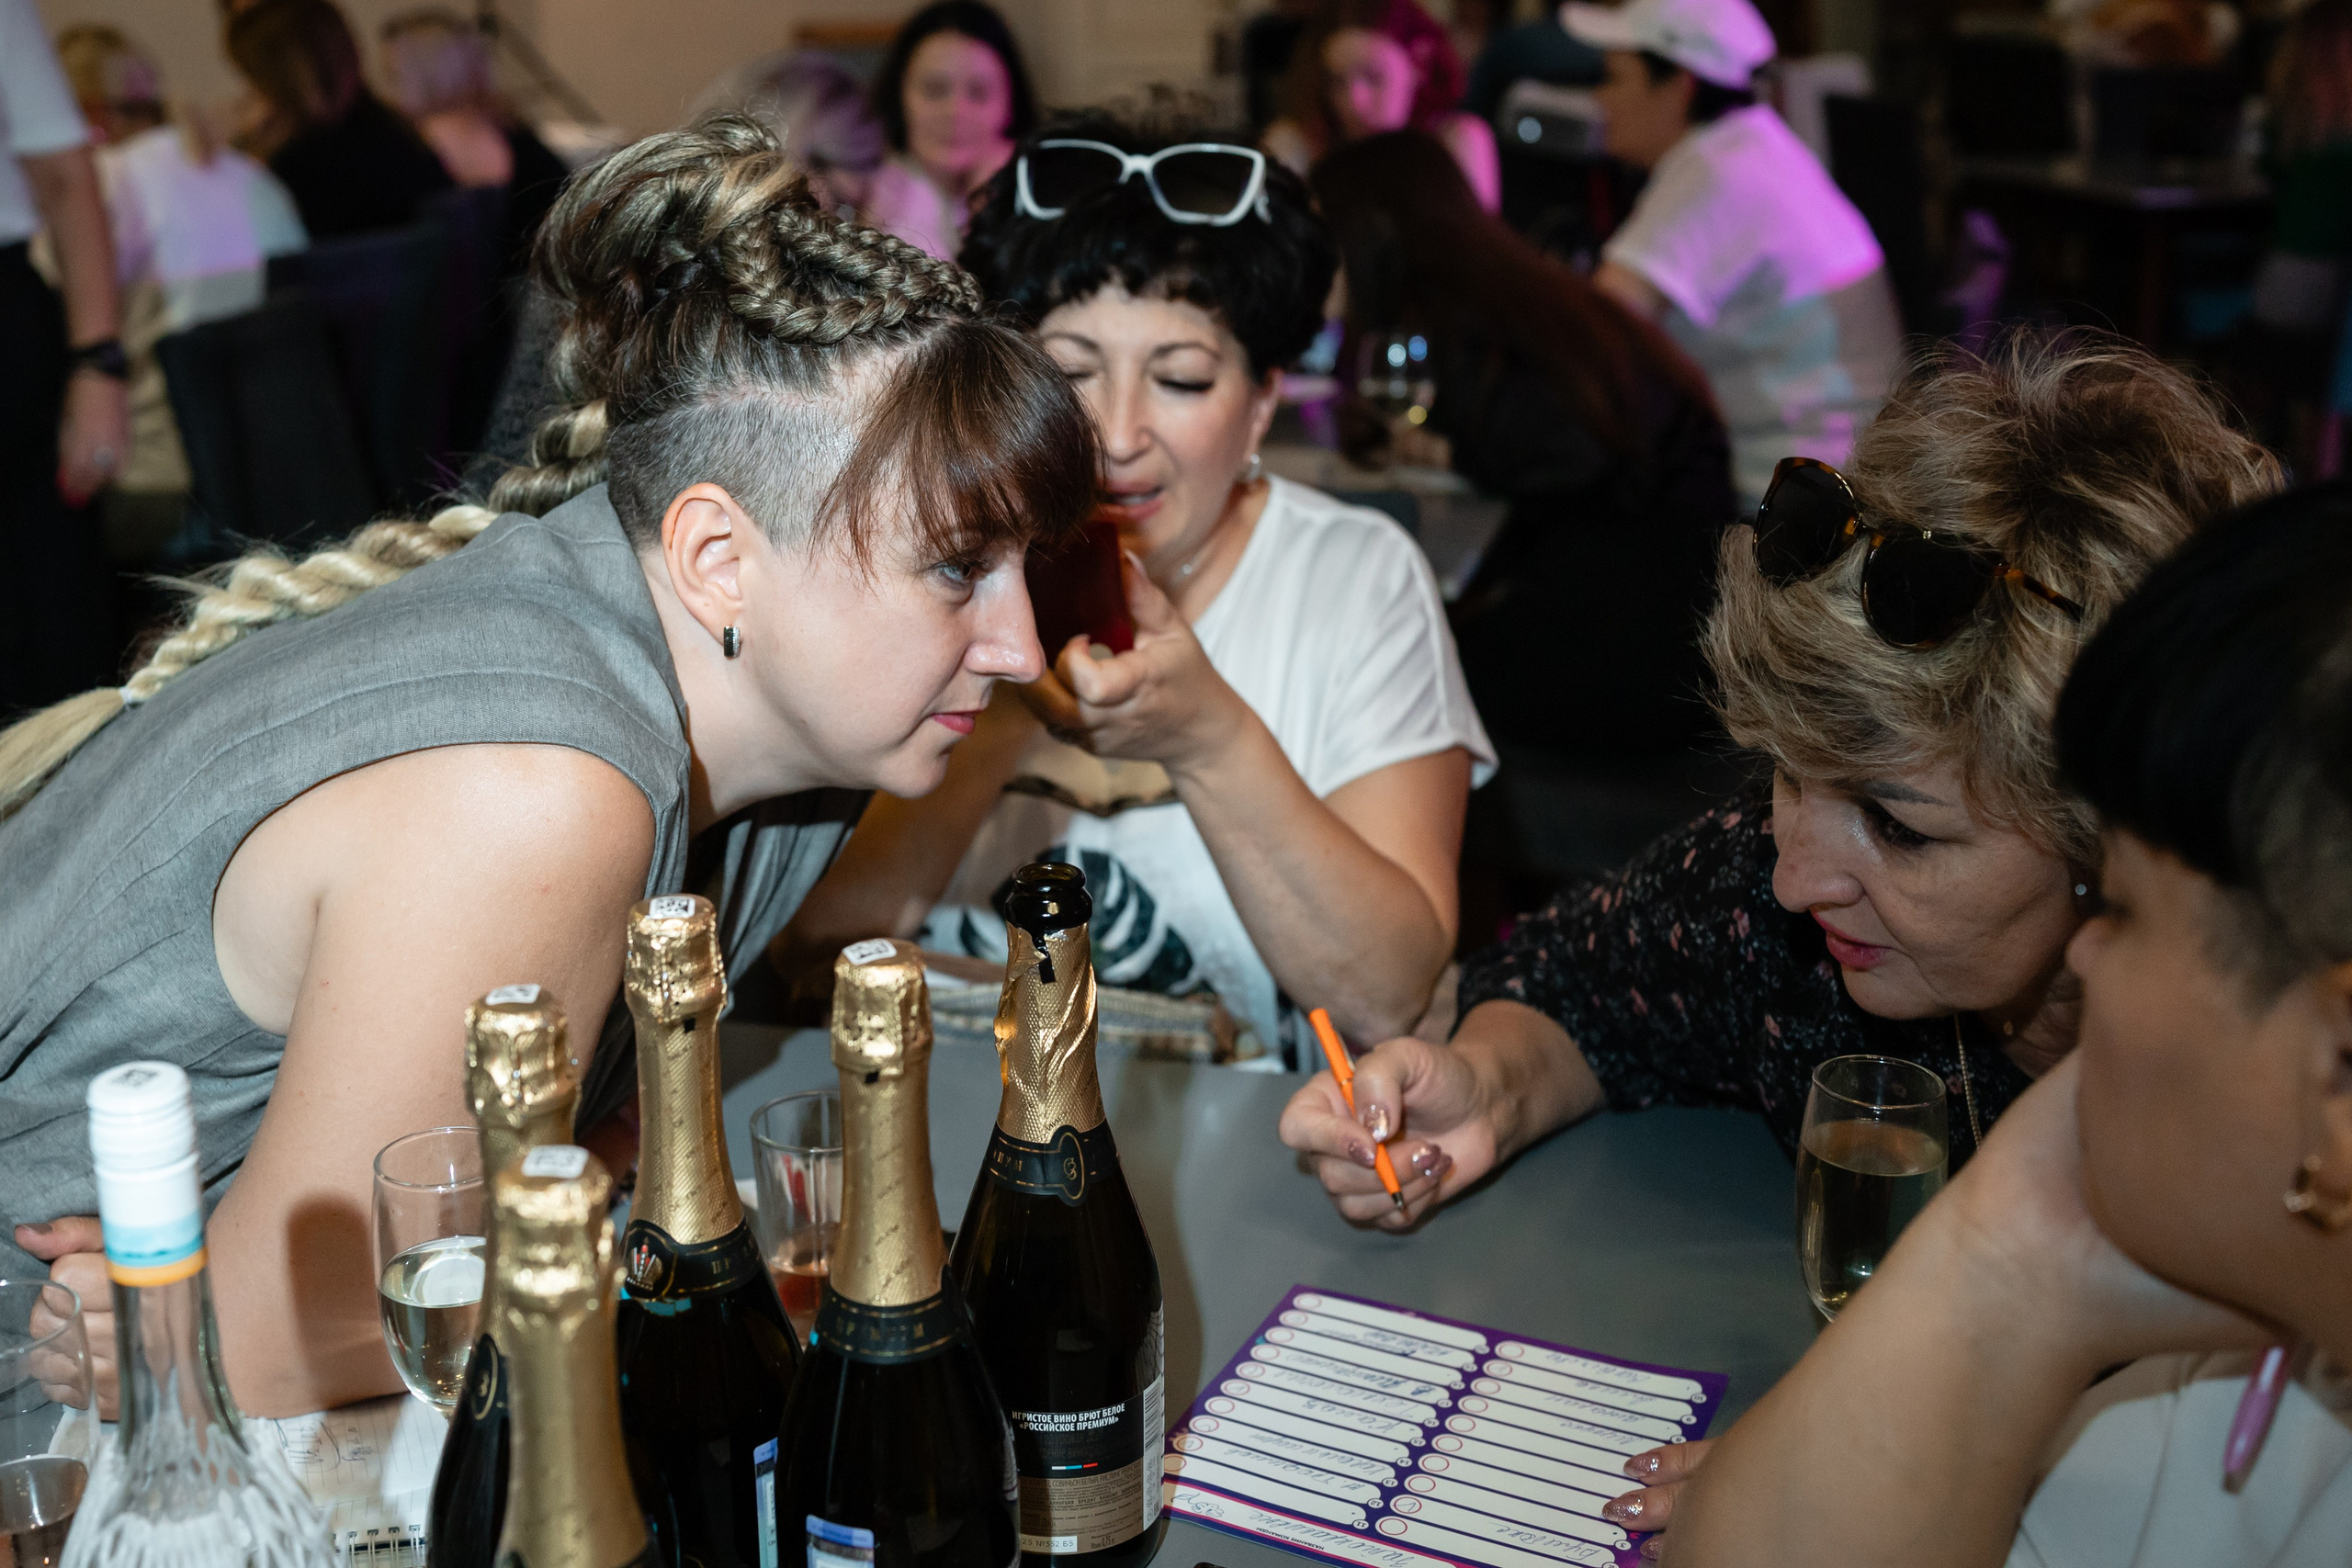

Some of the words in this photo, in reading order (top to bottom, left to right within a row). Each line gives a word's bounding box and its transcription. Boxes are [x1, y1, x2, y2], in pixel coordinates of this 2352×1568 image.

[1012, 1411, 1052, 1424] ИГРИСТОЕ
[1053, 1414, 1077, 1423] ВИНО
[1078, 1410, 1101, 1422] БРЮТ
[1102, 1403, 1125, 1417] БЕЛОЕ
[1020, 1422, 1075, 1432] «РОССИЙСКОЕ
[1077, 1416, 1119, 1430] ПРЕМИУМ»
[1255, 1526, 1290, 1540] КОМАНДЫ
[1294, 1539, 1325, 1551] НАЗВАНИЕ
